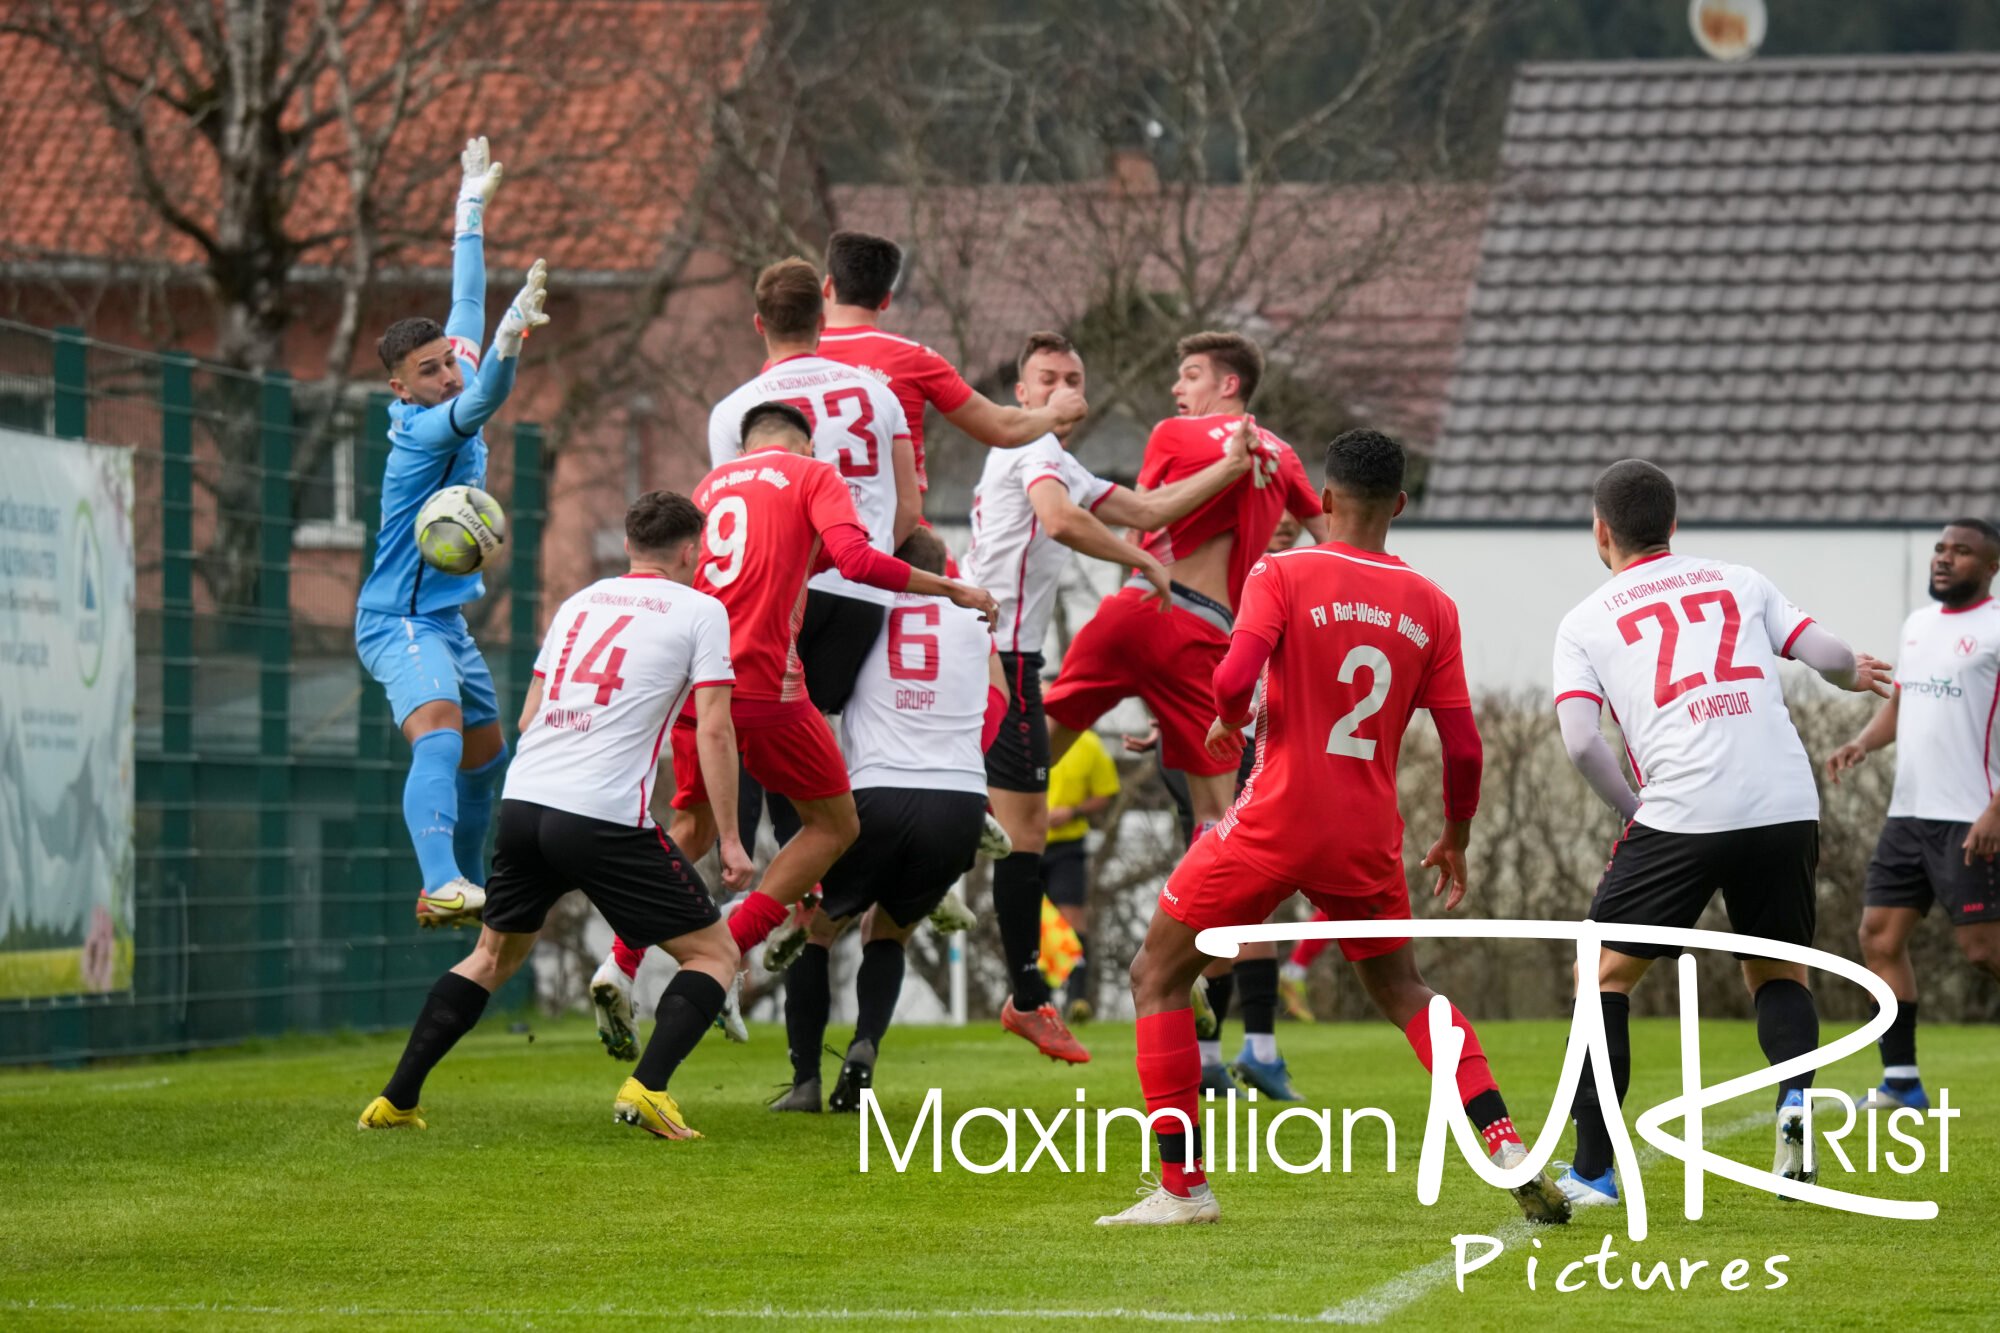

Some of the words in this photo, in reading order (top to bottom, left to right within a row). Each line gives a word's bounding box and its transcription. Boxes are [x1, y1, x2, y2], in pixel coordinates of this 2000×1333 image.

[458, 508, 495, 552] uhlsport
[704, 496, 747, 588] 9
[1612, 593, 1628, 608] FC
[1626, 574, 1688, 602] NORMANNIA
[1686, 568, 1724, 585] GMÜND
[888, 603, 940, 682] 6
[1310, 606, 1328, 628] FV
[1332, 602, 1392, 628] Rot-Weiss
[1397, 613, 1430, 650] Weiler
[1616, 589, 1765, 709] 22
[549, 611, 635, 706] 14
[896, 689, 935, 712] GRUPP
[1325, 644, 1393, 761] 2
[1687, 691, 1752, 726] KIANPOUR
